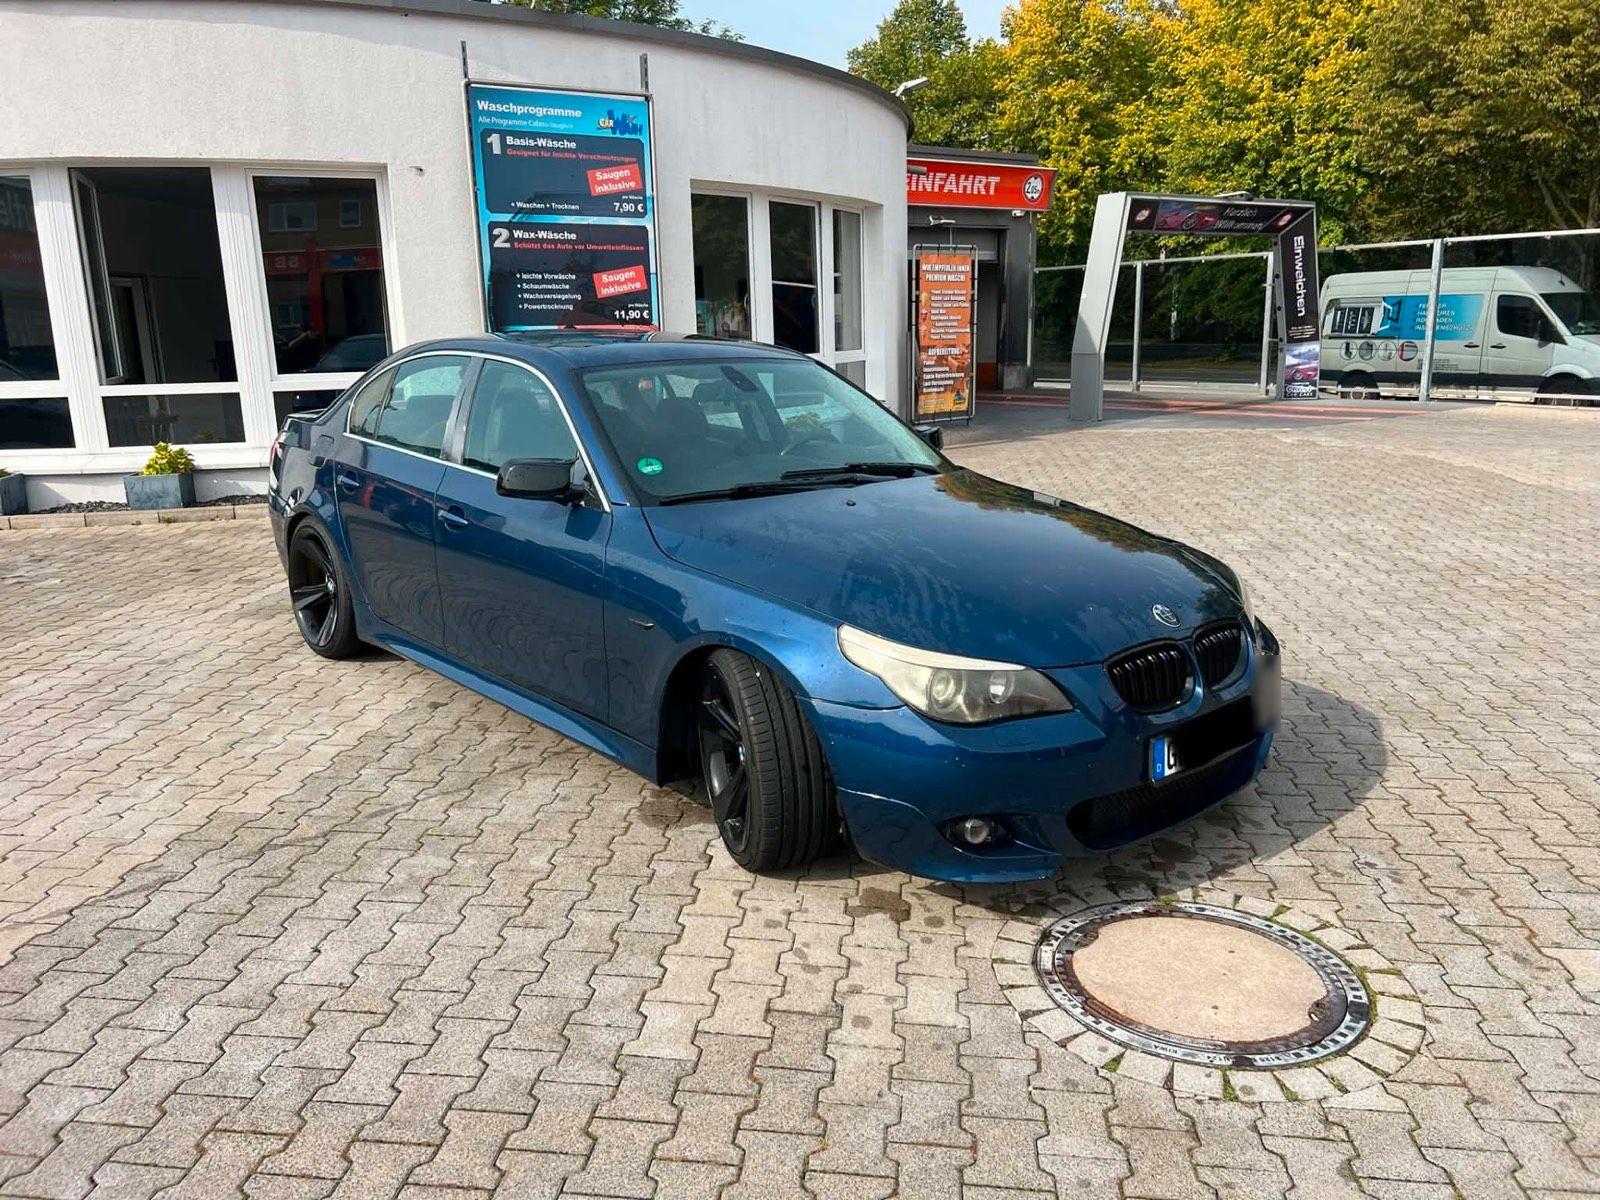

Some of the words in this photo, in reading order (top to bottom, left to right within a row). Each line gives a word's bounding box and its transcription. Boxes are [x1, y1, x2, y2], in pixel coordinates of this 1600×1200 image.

[477, 100, 582, 118] Waschprogramme
[492, 118, 527, 126] Programme
[486, 134, 501, 154] 1
[506, 136, 576, 149] Basis-Wäsche
[596, 169, 630, 181] Saugen
[595, 180, 636, 193] inklusive
[614, 203, 634, 212] 7,90
[637, 204, 644, 212] €
[493, 228, 510, 248] 2
[513, 230, 577, 240] Wax-Wäsche
[602, 271, 635, 283] Saugen
[1294, 235, 1306, 317] Einweichen
[614, 310, 640, 320] 11,90
